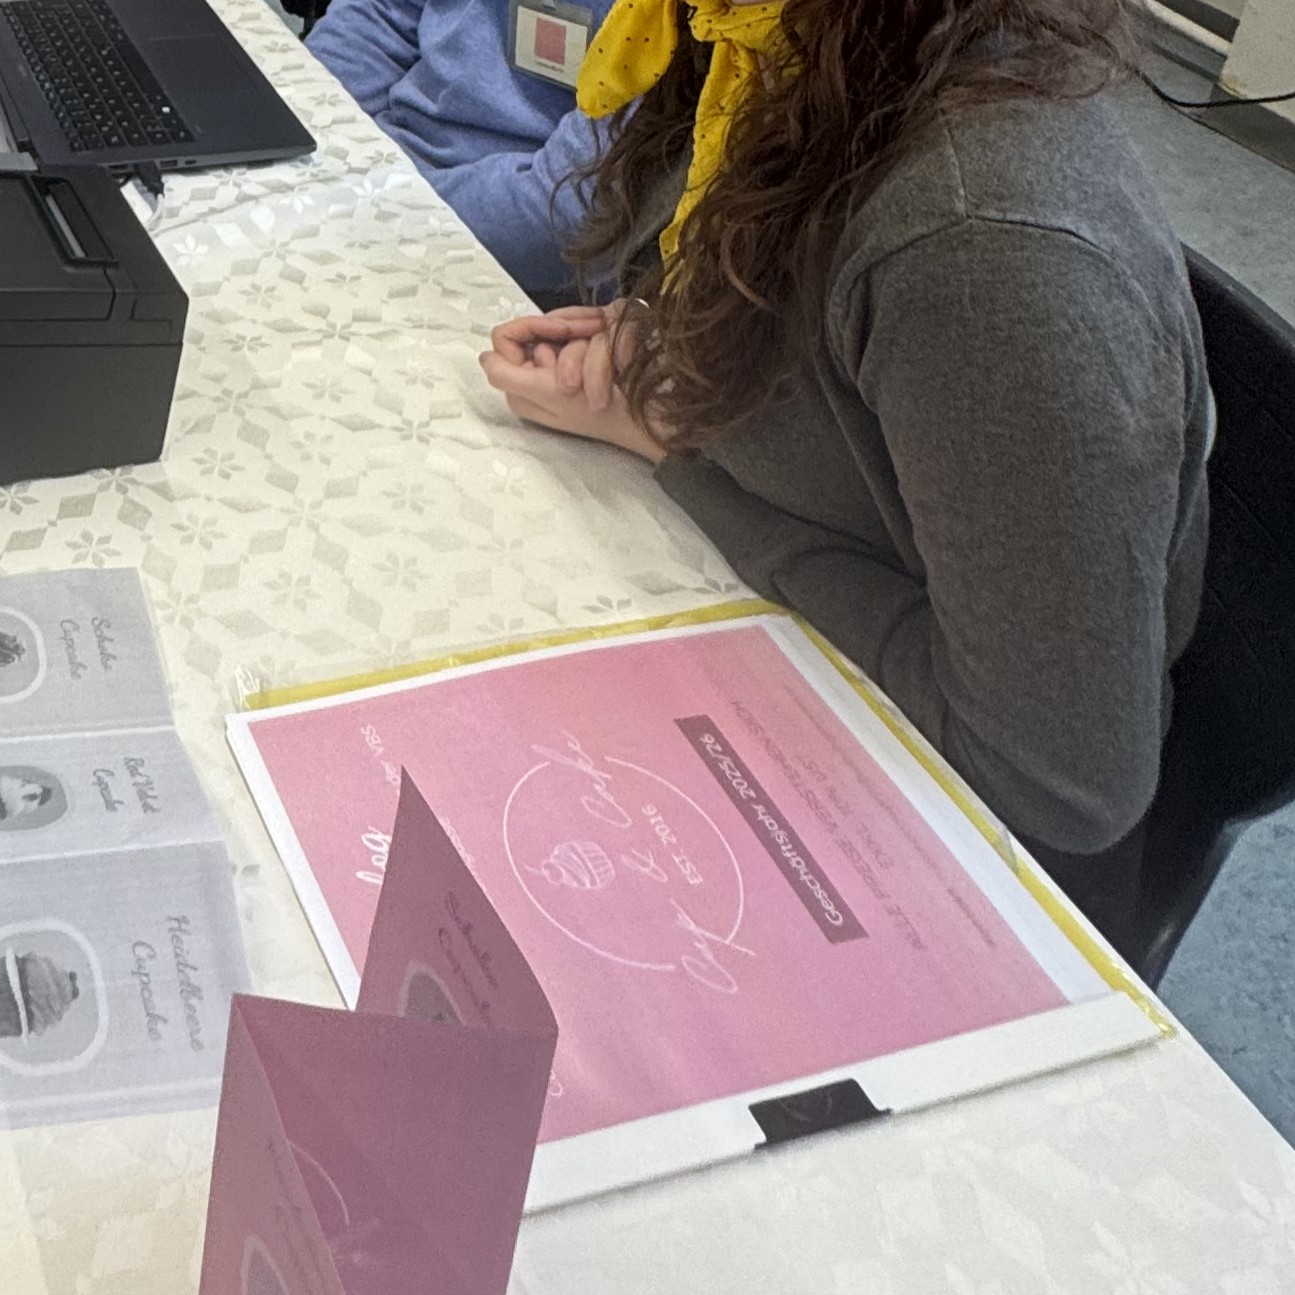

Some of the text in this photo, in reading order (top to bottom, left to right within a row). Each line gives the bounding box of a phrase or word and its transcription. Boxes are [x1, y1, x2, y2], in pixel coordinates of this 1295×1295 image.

[58, 618, 89, 680] Cupcake
[700, 733, 756, 801] 2025/26
[641, 804, 677, 847] 2016
[753, 804, 844, 928] Geschäftsjahr
[131, 940, 169, 1042] Cupcake
[166, 915, 205, 1052] Heidelbeere
